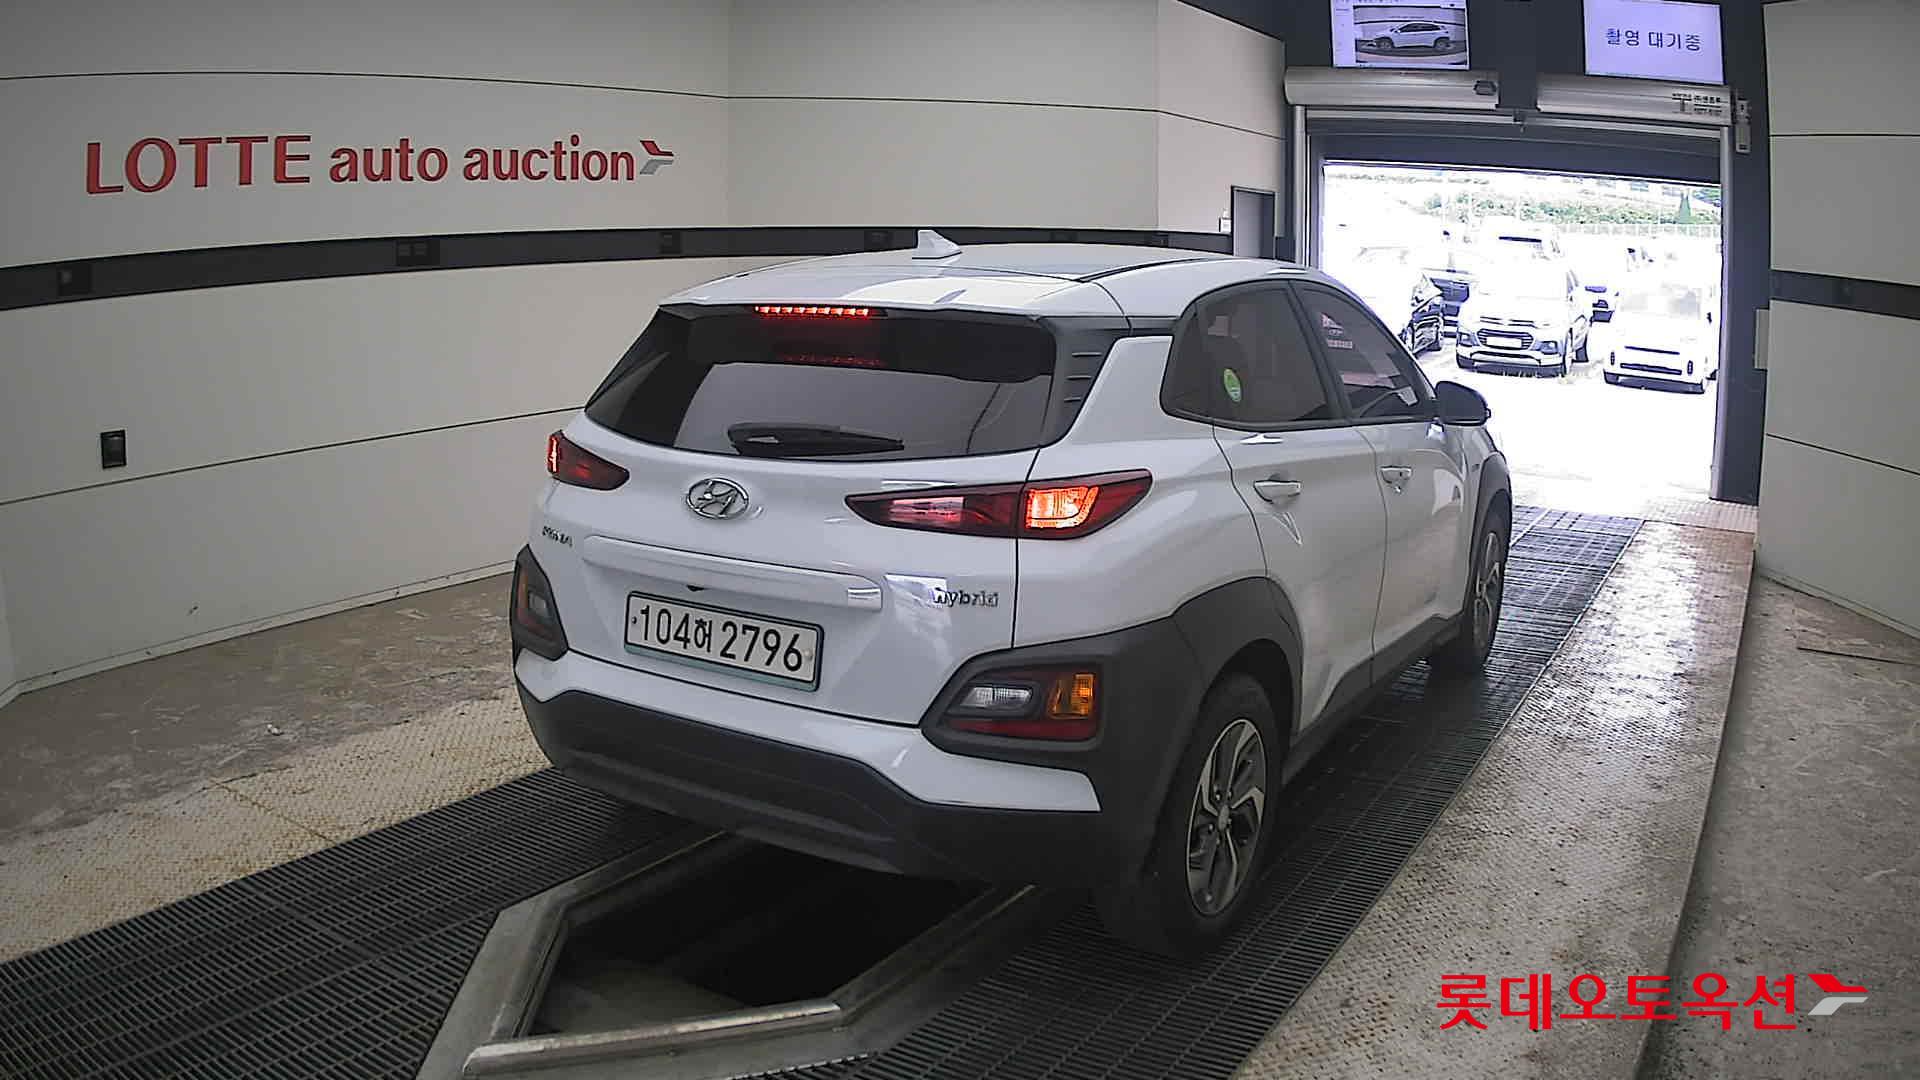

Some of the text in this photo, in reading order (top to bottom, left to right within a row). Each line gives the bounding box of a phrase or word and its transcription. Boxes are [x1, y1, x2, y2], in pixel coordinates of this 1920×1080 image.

[1648, 31, 1701, 52] 대기중
[86, 134, 635, 194] LOTTE auto auction
[931, 586, 999, 608] hybrid
[640, 604, 803, 672] 104허 2796
